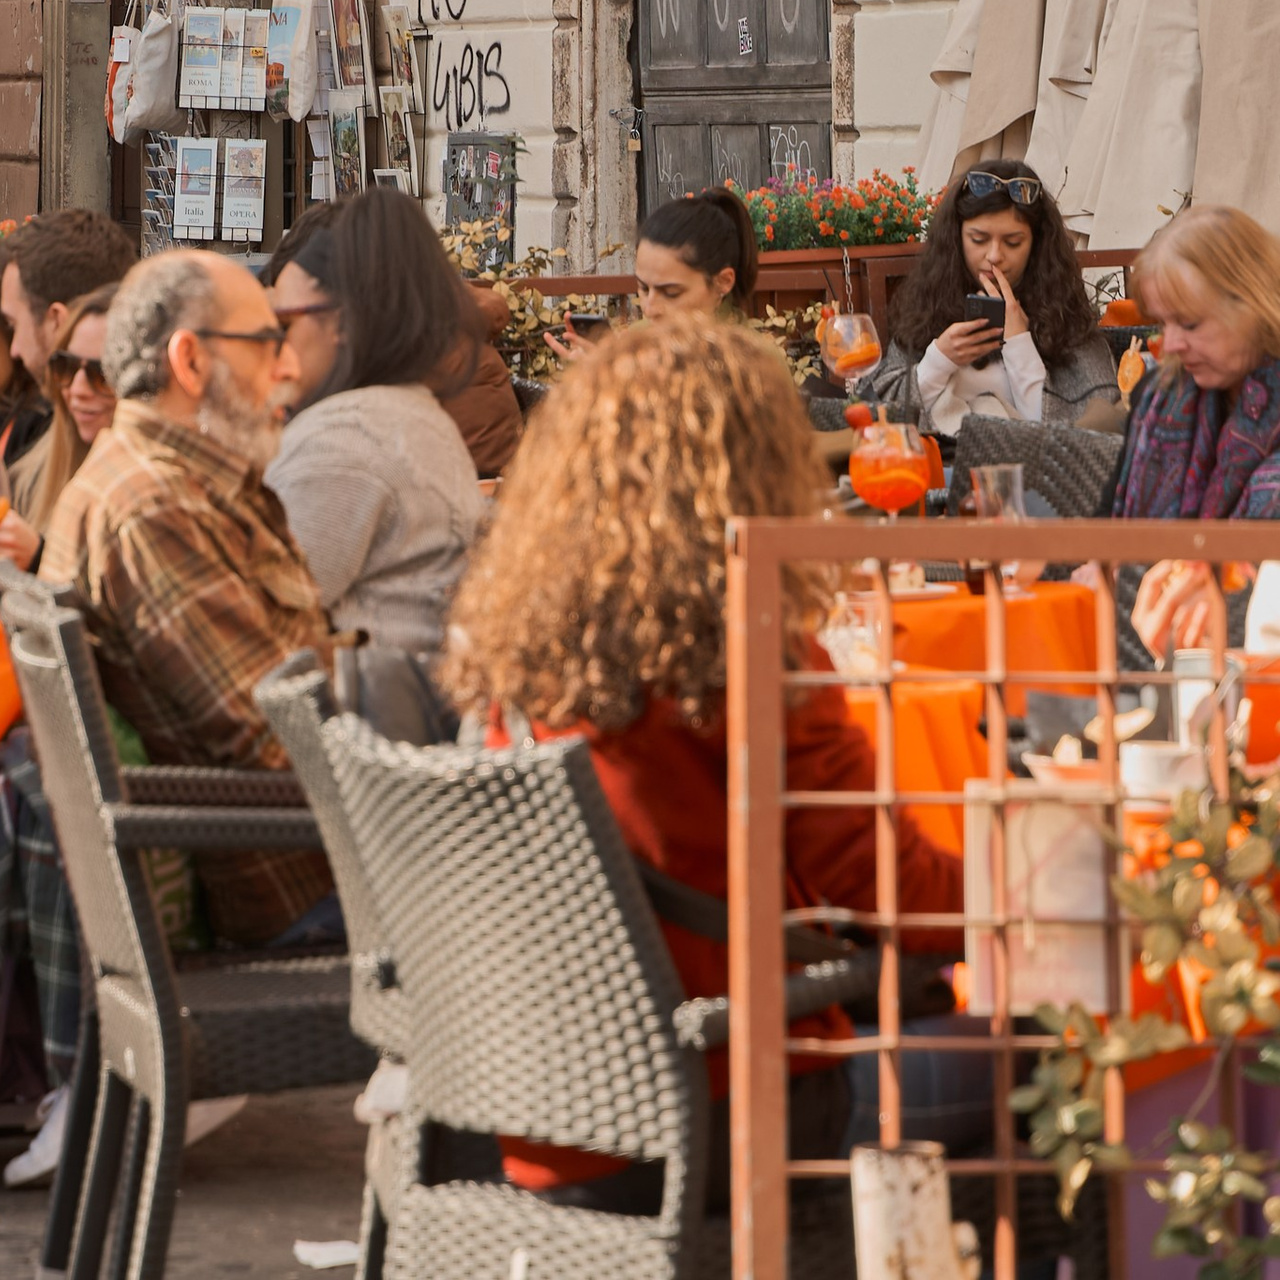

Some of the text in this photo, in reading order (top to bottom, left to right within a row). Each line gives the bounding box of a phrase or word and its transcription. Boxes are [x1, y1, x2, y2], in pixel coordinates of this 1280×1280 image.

[188, 79, 213, 87] ROMA
[184, 207, 204, 216] Italia
[229, 210, 257, 218] OPERA
